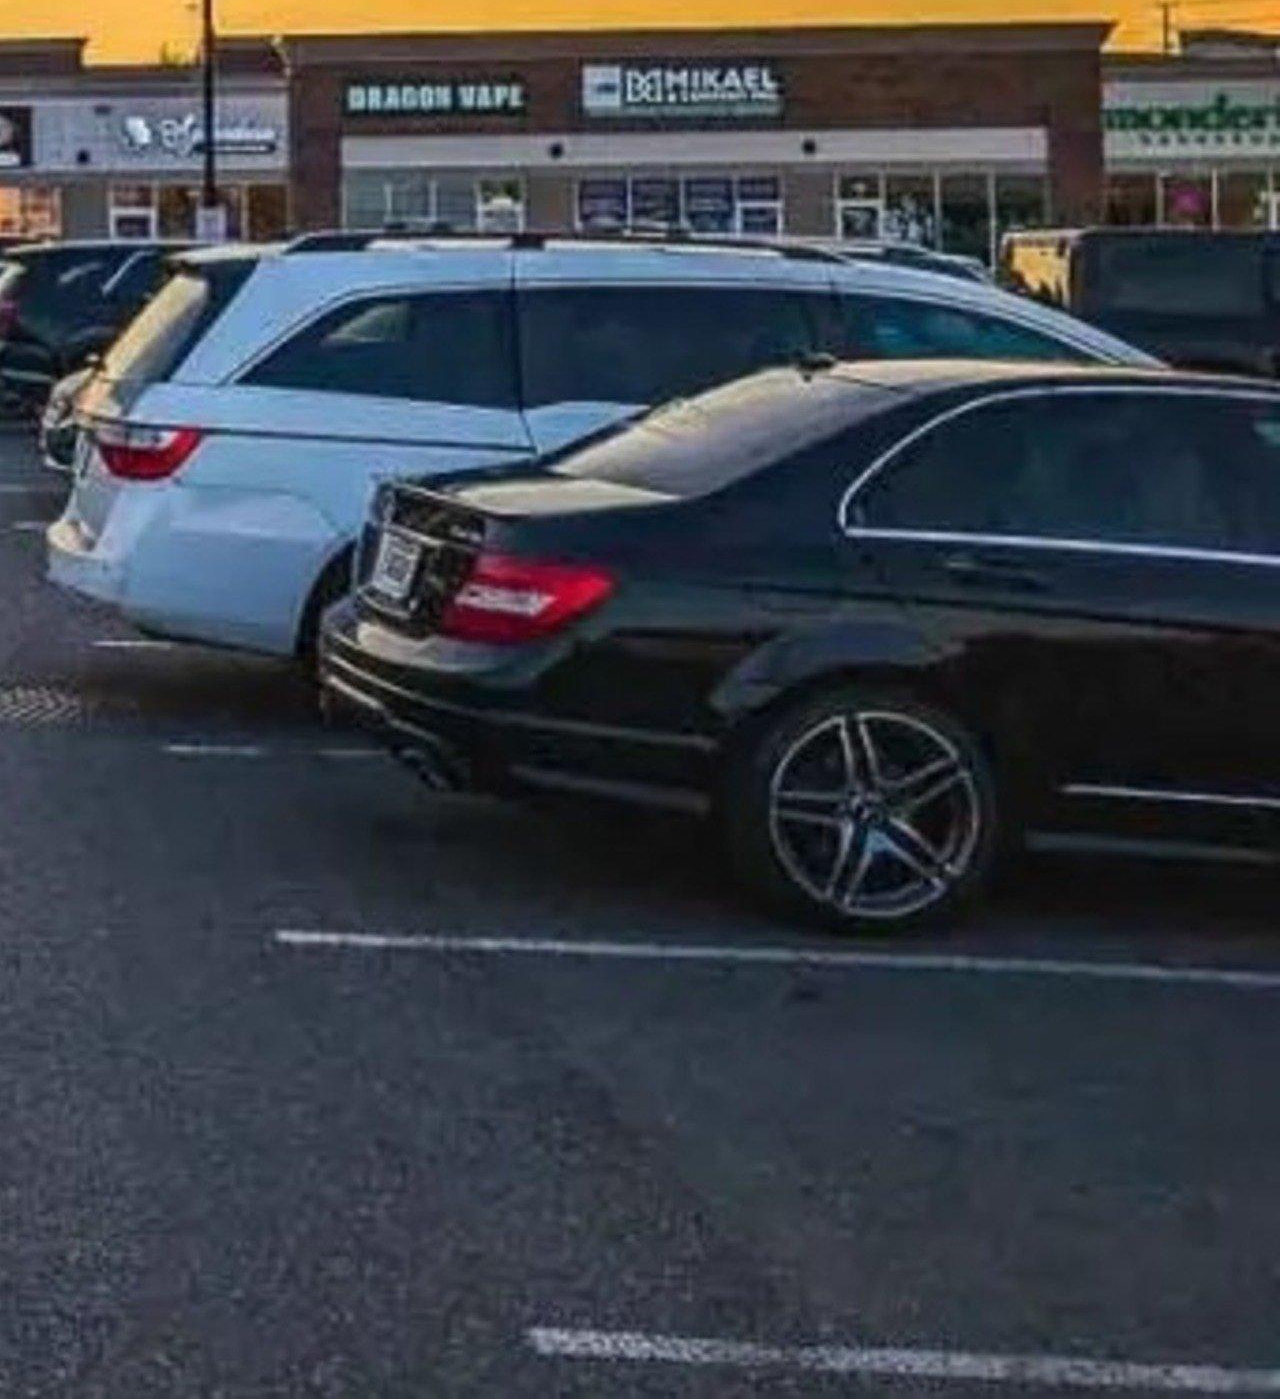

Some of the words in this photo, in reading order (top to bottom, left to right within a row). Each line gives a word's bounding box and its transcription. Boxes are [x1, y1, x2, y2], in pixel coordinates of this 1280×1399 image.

[665, 68, 778, 90] MIKAEL
[347, 85, 452, 111] DRAGON
[458, 84, 524, 108] VAPE
